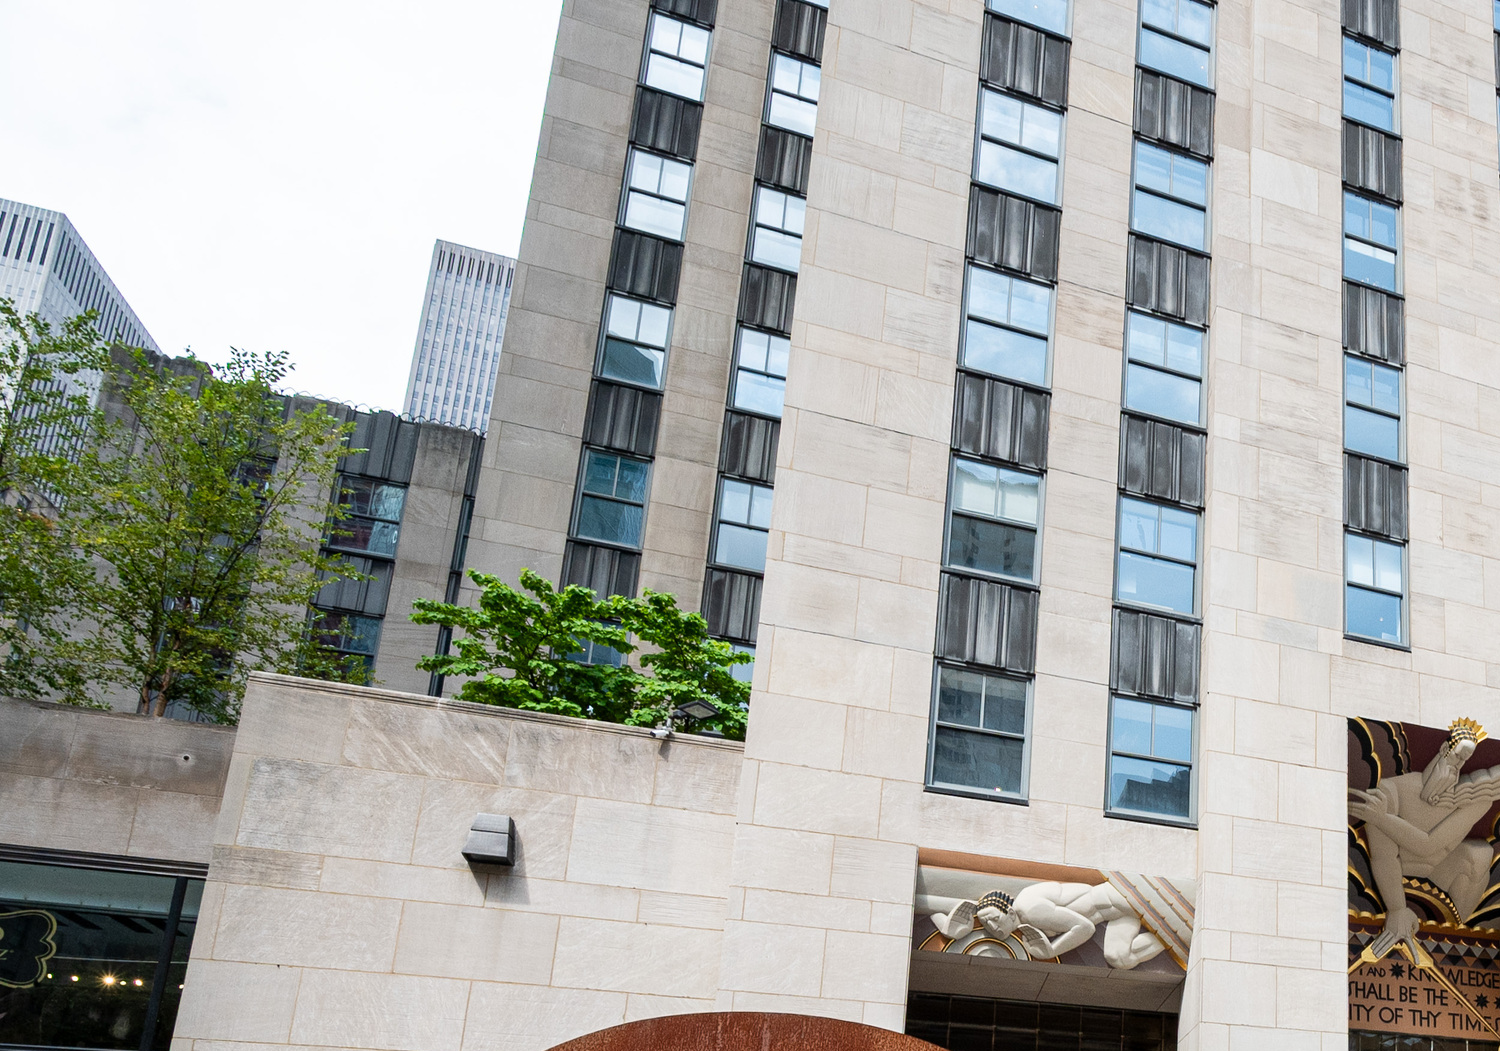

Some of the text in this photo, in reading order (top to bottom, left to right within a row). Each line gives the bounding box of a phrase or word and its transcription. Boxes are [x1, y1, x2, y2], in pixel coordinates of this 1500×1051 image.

[1366, 964, 1500, 989] AND KNWLEDGE
[1399, 985, 1418, 1003] BE
[1423, 987, 1449, 1006] THE
[1378, 1006, 1403, 1024] OF
[1408, 1009, 1442, 1028] THY
[1448, 1012, 1500, 1032] TIMES
